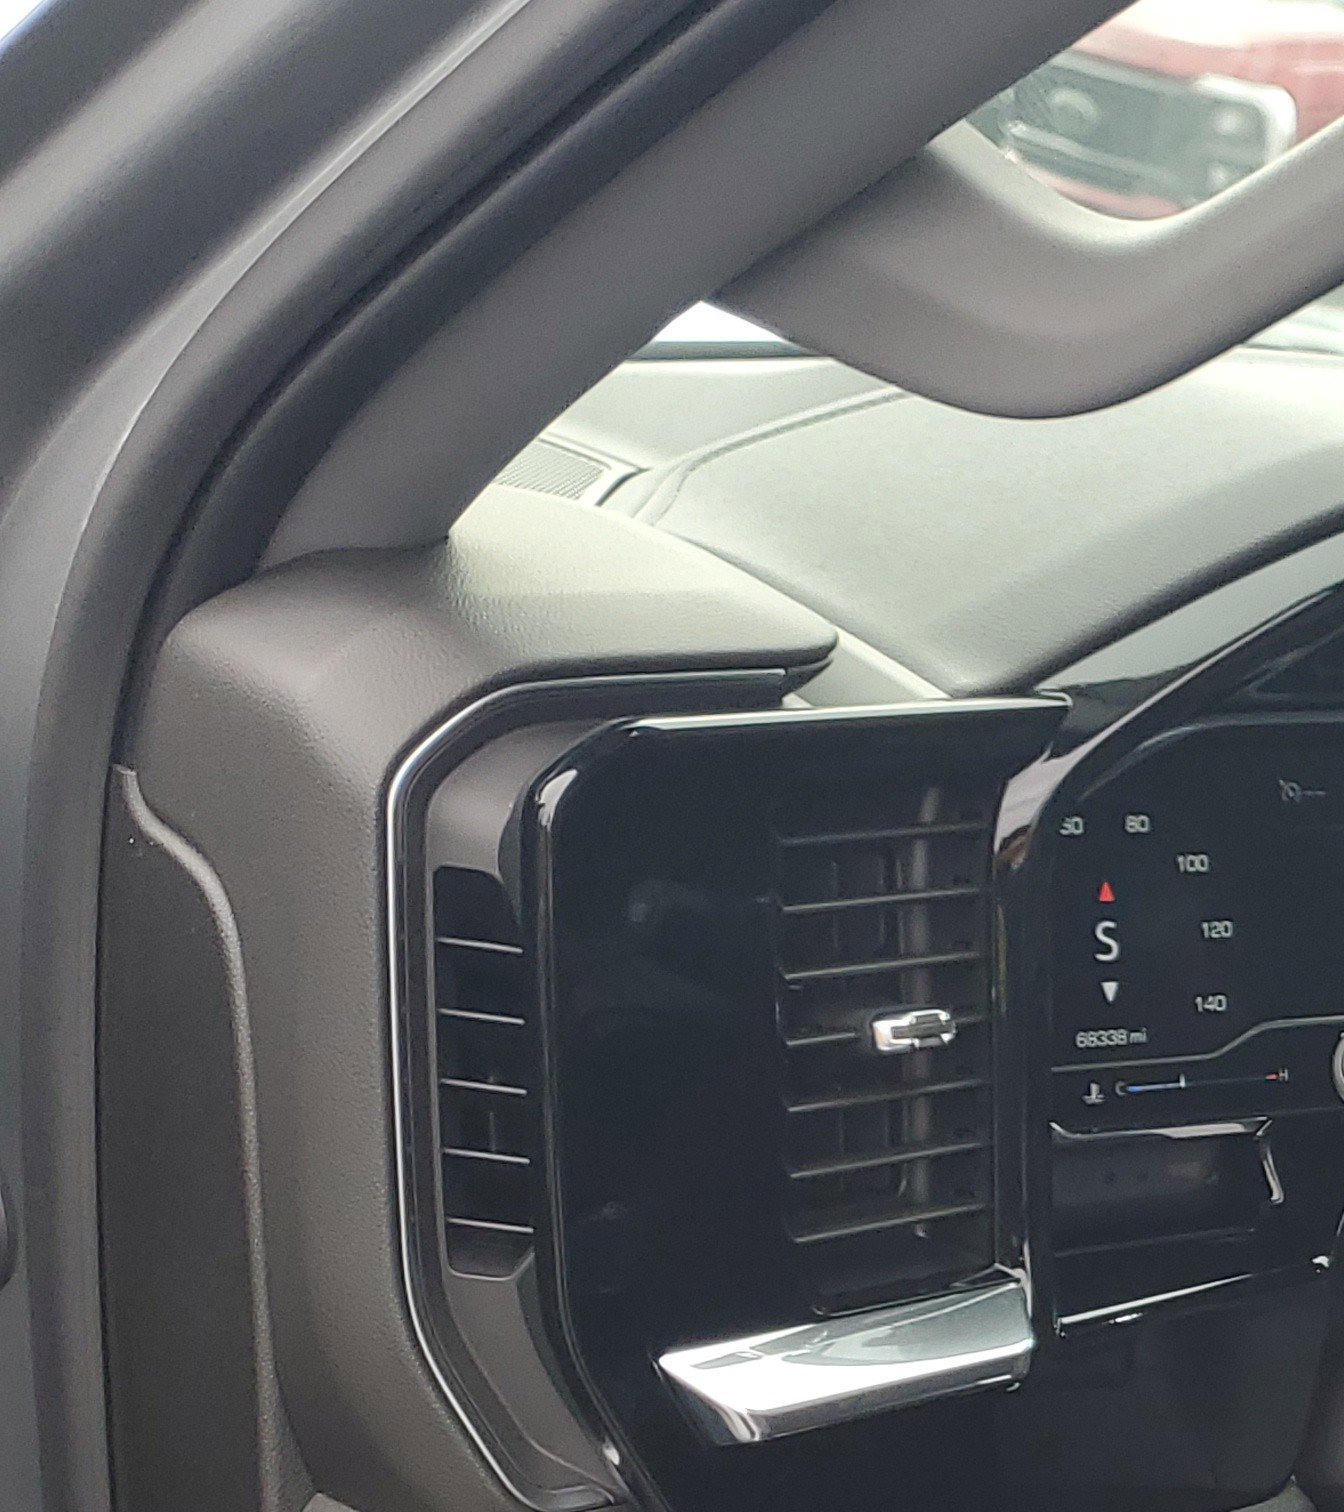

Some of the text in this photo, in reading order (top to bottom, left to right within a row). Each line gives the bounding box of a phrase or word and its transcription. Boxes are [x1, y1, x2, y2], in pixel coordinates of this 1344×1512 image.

[1176, 853, 1210, 873] 100
[1200, 920, 1234, 939] 120
[1094, 920, 1120, 962] S
[1194, 994, 1228, 1012] 140
